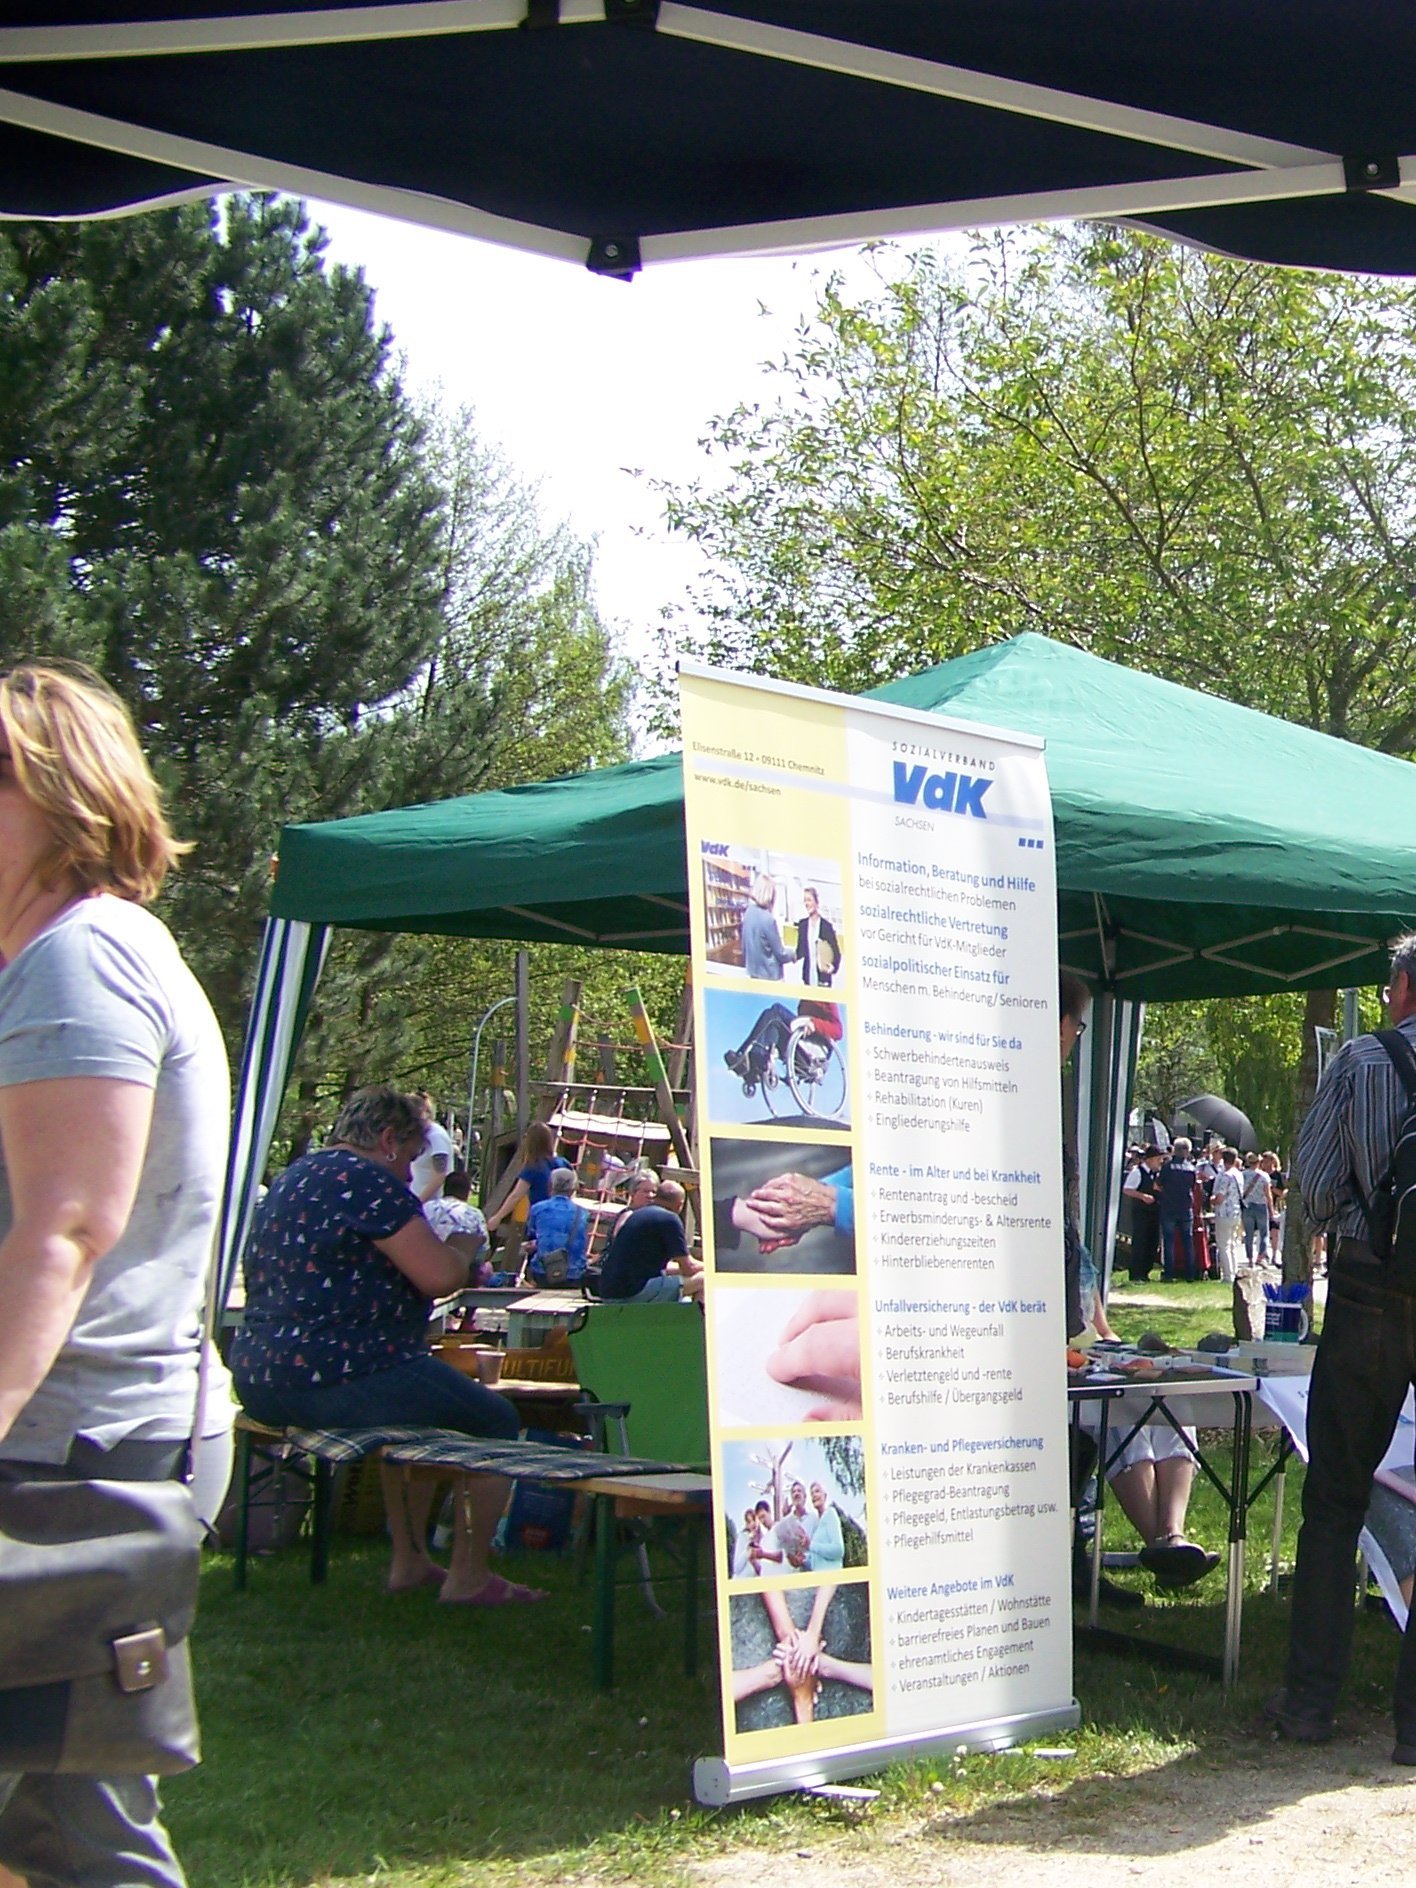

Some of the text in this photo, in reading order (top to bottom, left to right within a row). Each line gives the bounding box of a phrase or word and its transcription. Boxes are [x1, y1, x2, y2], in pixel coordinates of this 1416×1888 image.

[745, 752, 753, 761] 12
[762, 755, 785, 768] 09111
[788, 761, 824, 775] Chemnitz
[892, 741, 996, 771] SOZIALVERBAND
[694, 773, 781, 795] www.vdk.de/sachsen
[893, 760, 994, 819] VdK
[895, 816, 934, 831] SACHSEN
[701, 840, 730, 857] VdK
[858, 852, 1036, 892] Information, Beratung und Hilfe
[859, 875, 1016, 911] bei sozialrechtlichen Problemen
[860, 904, 1008, 940] sozialrechtliche Vertretung
[860, 927, 1007, 958] vor Gericht für VdK-Mitglieder
[862, 955, 1010, 984] sozialpolitischer Einsatz für
[863, 977, 916, 995] Menschen
[918, 985, 931, 996] m.
[1000, 994, 1048, 1009] Senioren
[864, 1021, 931, 1043] Behinderung
[938, 1031, 954, 1042] wir
[955, 1031, 974, 1045] sind
[976, 1034, 990, 1046] für
[992, 1037, 1007, 1048] Sie
[1009, 1037, 1022, 1050] da
[873, 1047, 1010, 1072] Schwerbehindertenausweis
[875, 1069, 1018, 1094] Beantragung von Hilfsmitteln
[875, 1091, 983, 1114] Rehabilitation (Kuren)
[876, 1113, 970, 1134] Eingliederungshilfe
[870, 1162, 899, 1176] Rente
[909, 1164, 923, 1177] im
[926, 1166, 950, 1179] Alter
[952, 1168, 971, 1181] und
[974, 1168, 989, 1182] bei
[992, 1171, 1041, 1184] Krankheit
[879, 1188, 1018, 1206] Rentenantrag und -bescheid
[880, 1210, 1051, 1229] Erwerbsminderungs- & Altersrente
[881, 1232, 996, 1250] Kindererziehungszeiten
[882, 1255, 994, 1270] Hinterbliebenenrenten
[875, 1300, 970, 1315] Unfallversicherung
[979, 1301, 995, 1313] der
[998, 1301, 1017, 1312] VdK
[1020, 1300, 1047, 1313] berät
[885, 1324, 1004, 1340] Arbeits- und Wegeunfall
[886, 1347, 965, 1360] Berufskrankheit
[887, 1368, 1013, 1384] Verletztengeld und -rente
[888, 1388, 1023, 1405] Berufshilfe / Übergangsgeld
[881, 1436, 1043, 1455] Kranken- und Pflegeversicherung
[891, 1460, 1036, 1481] Leistungen der Krankenkassen
[893, 1484, 1009, 1504] Pflegegrad-Beantragung
[893, 1503, 1058, 1527] Pflegegeld, Entlastungsbetrag usw.
[894, 1529, 974, 1549] Pflegehilfsmittel
[887, 1574, 1014, 1600] Weitere Angebote im VdK
[897, 1595, 1051, 1624] Kindertagesstätten / Wohnstätte
[898, 1617, 1050, 1647] barrierefreies Planen und Bauen
[899, 1640, 1034, 1669] ehrenamtliches Engagement
[899, 1663, 1030, 1692] Veranstaltungen / Aktionen
